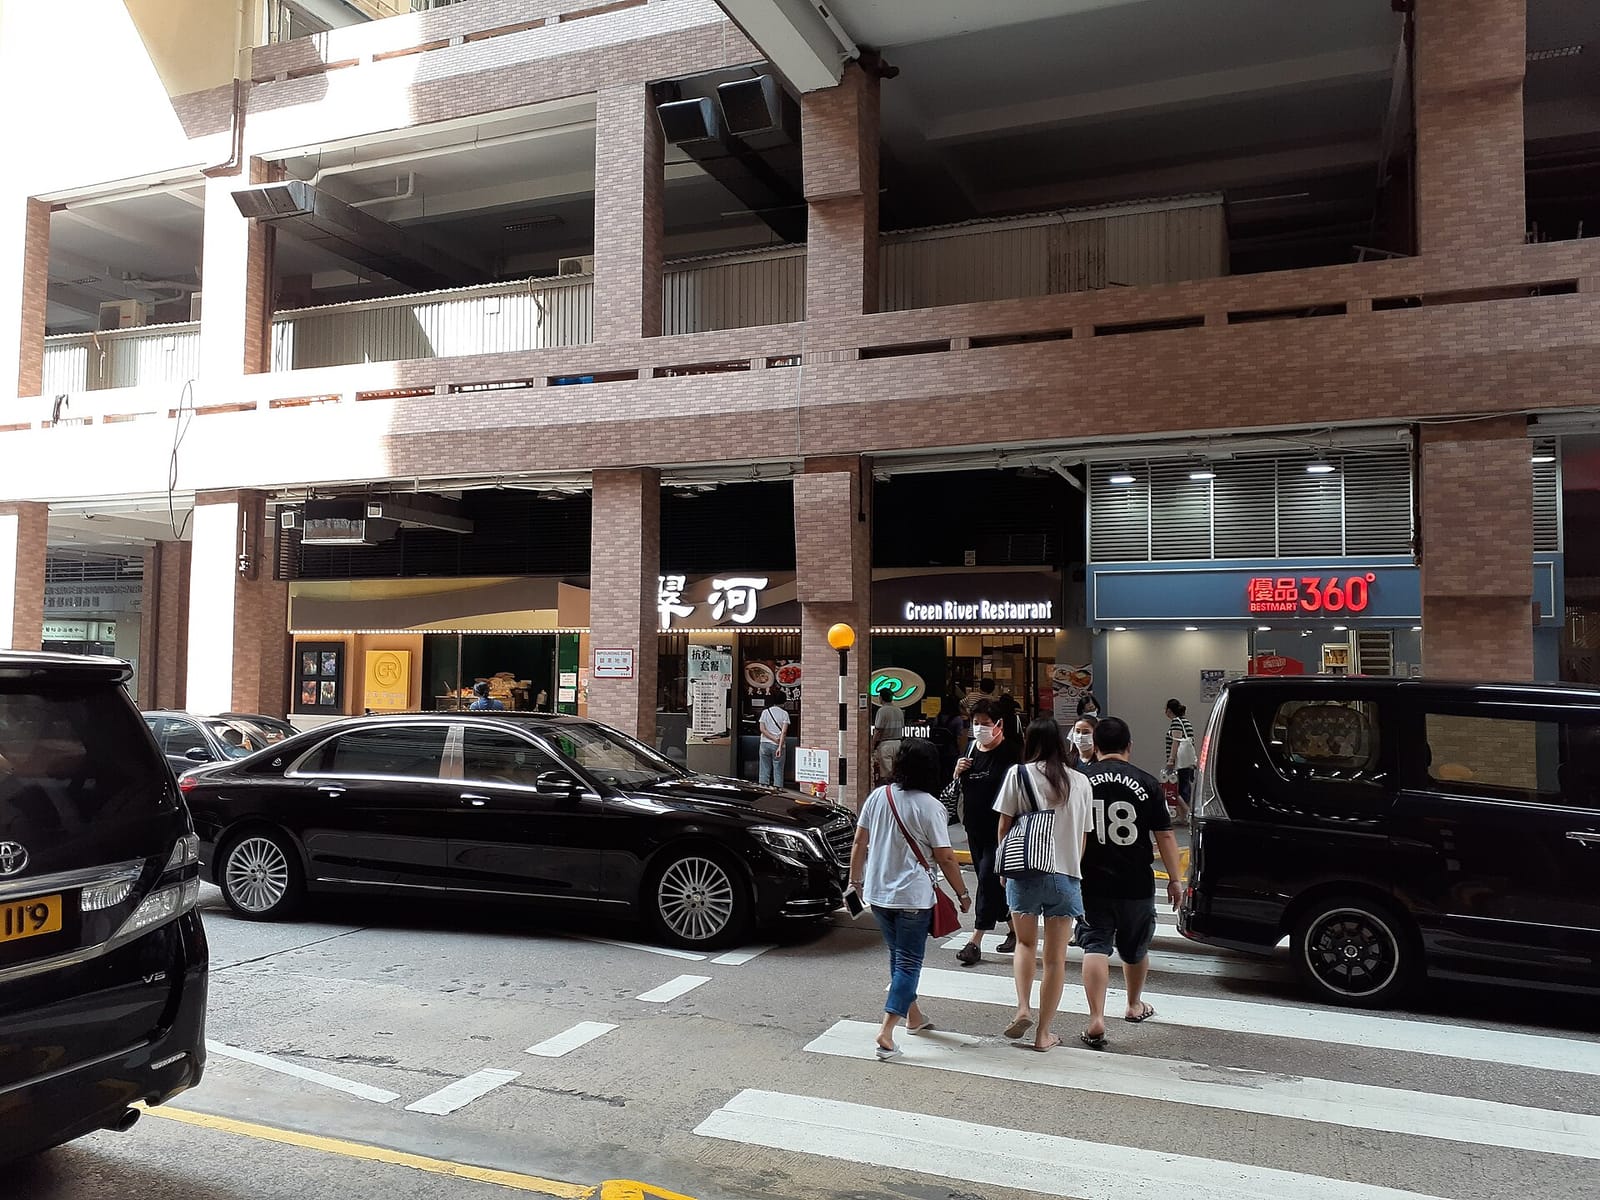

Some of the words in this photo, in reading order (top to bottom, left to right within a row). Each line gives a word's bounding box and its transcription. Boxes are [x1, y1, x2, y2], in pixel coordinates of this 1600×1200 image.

[1248, 577, 1299, 602] 優品
[905, 601, 943, 620] Green
[944, 601, 979, 620] River
[981, 600, 1053, 620] Restaurant
[1250, 602, 1298, 612] BESTMART
[692, 649, 711, 660] 抗疫
[700, 660, 720, 672] 套餐
[1092, 799, 1138, 846] 18
[5, 902, 49, 936] 119
